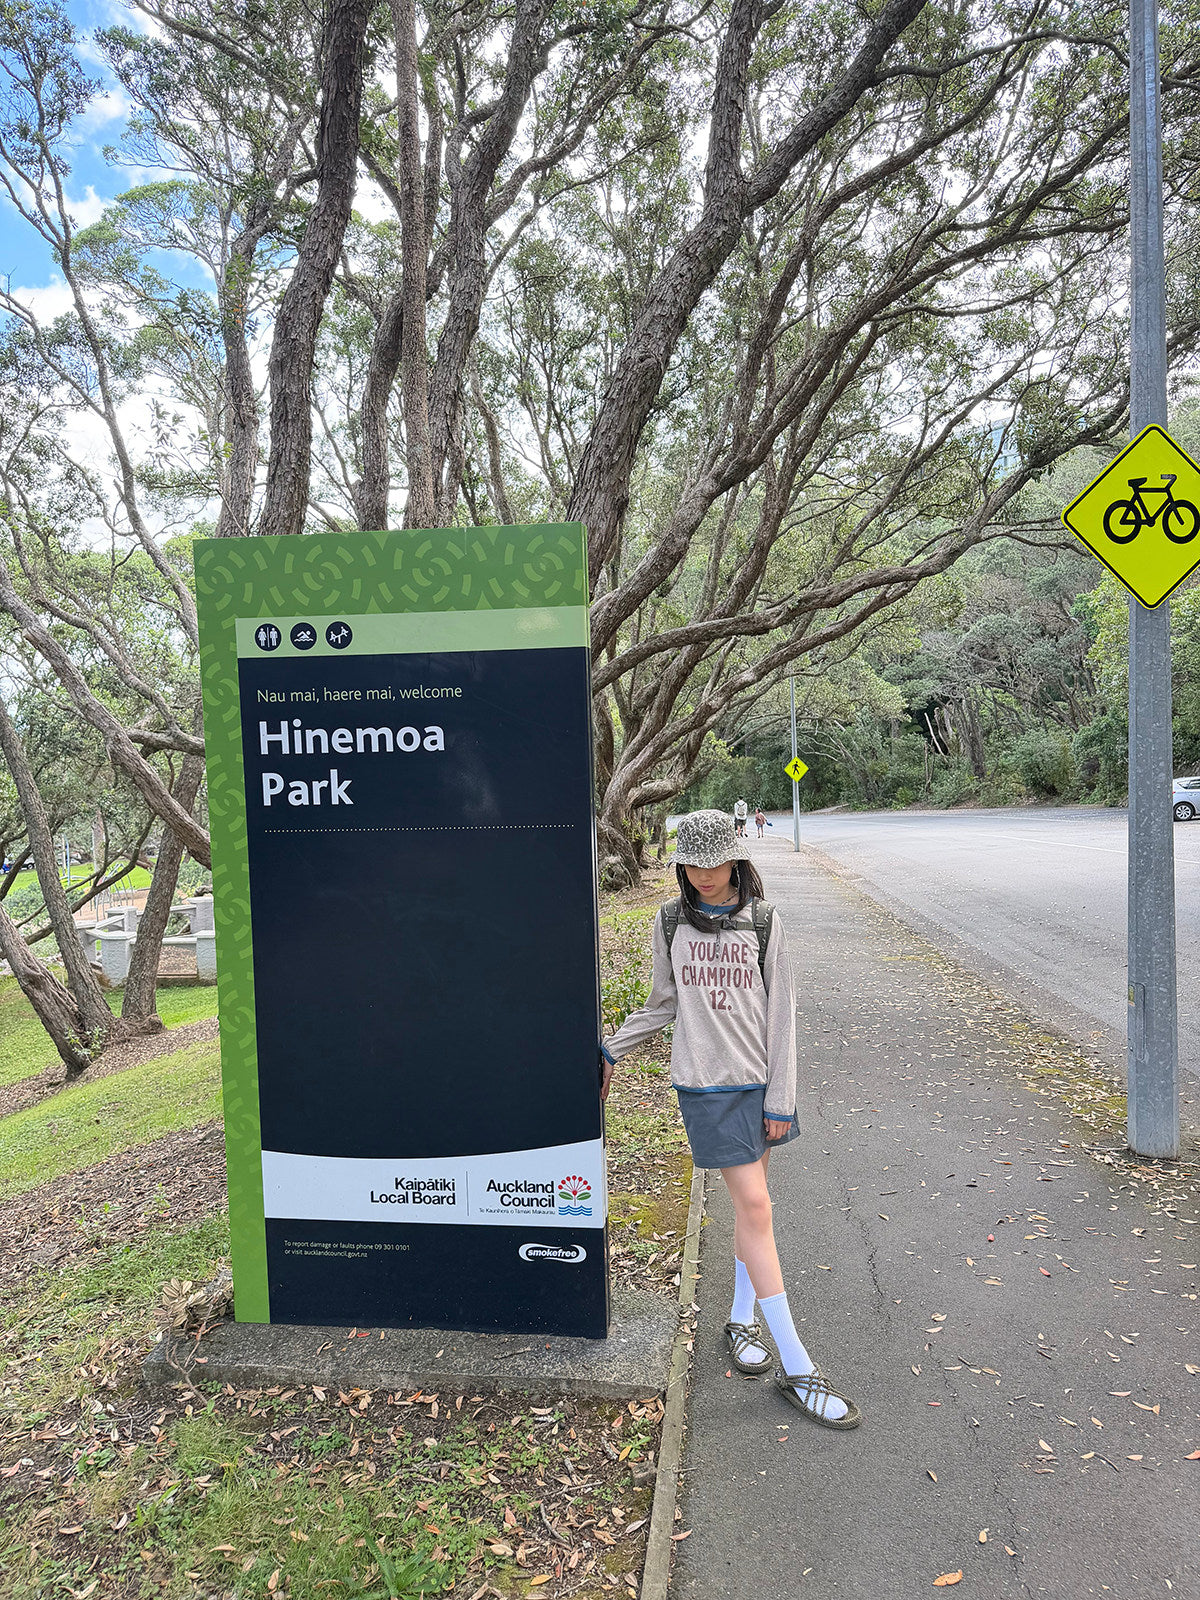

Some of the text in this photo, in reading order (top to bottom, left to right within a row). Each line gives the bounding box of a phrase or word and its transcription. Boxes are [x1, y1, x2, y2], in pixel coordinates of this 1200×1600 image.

[257, 685, 462, 703] Nau mai, haere mai, welcome
[259, 718, 445, 755] Hinemoa
[261, 768, 354, 806] Park
[688, 941, 749, 964] YOU ARE
[681, 965, 753, 989] CHAMPION
[709, 990, 733, 1011] 12.
[394, 1177, 456, 1192] Kaipātiki
[486, 1179, 555, 1193] Auckland
[370, 1190, 456, 1205] Local Board
[500, 1193, 555, 1208] Council
[310, 1241, 332, 1249] damage
[356, 1243, 373, 1251] phone
[527, 1249, 577, 1258] smokefree
